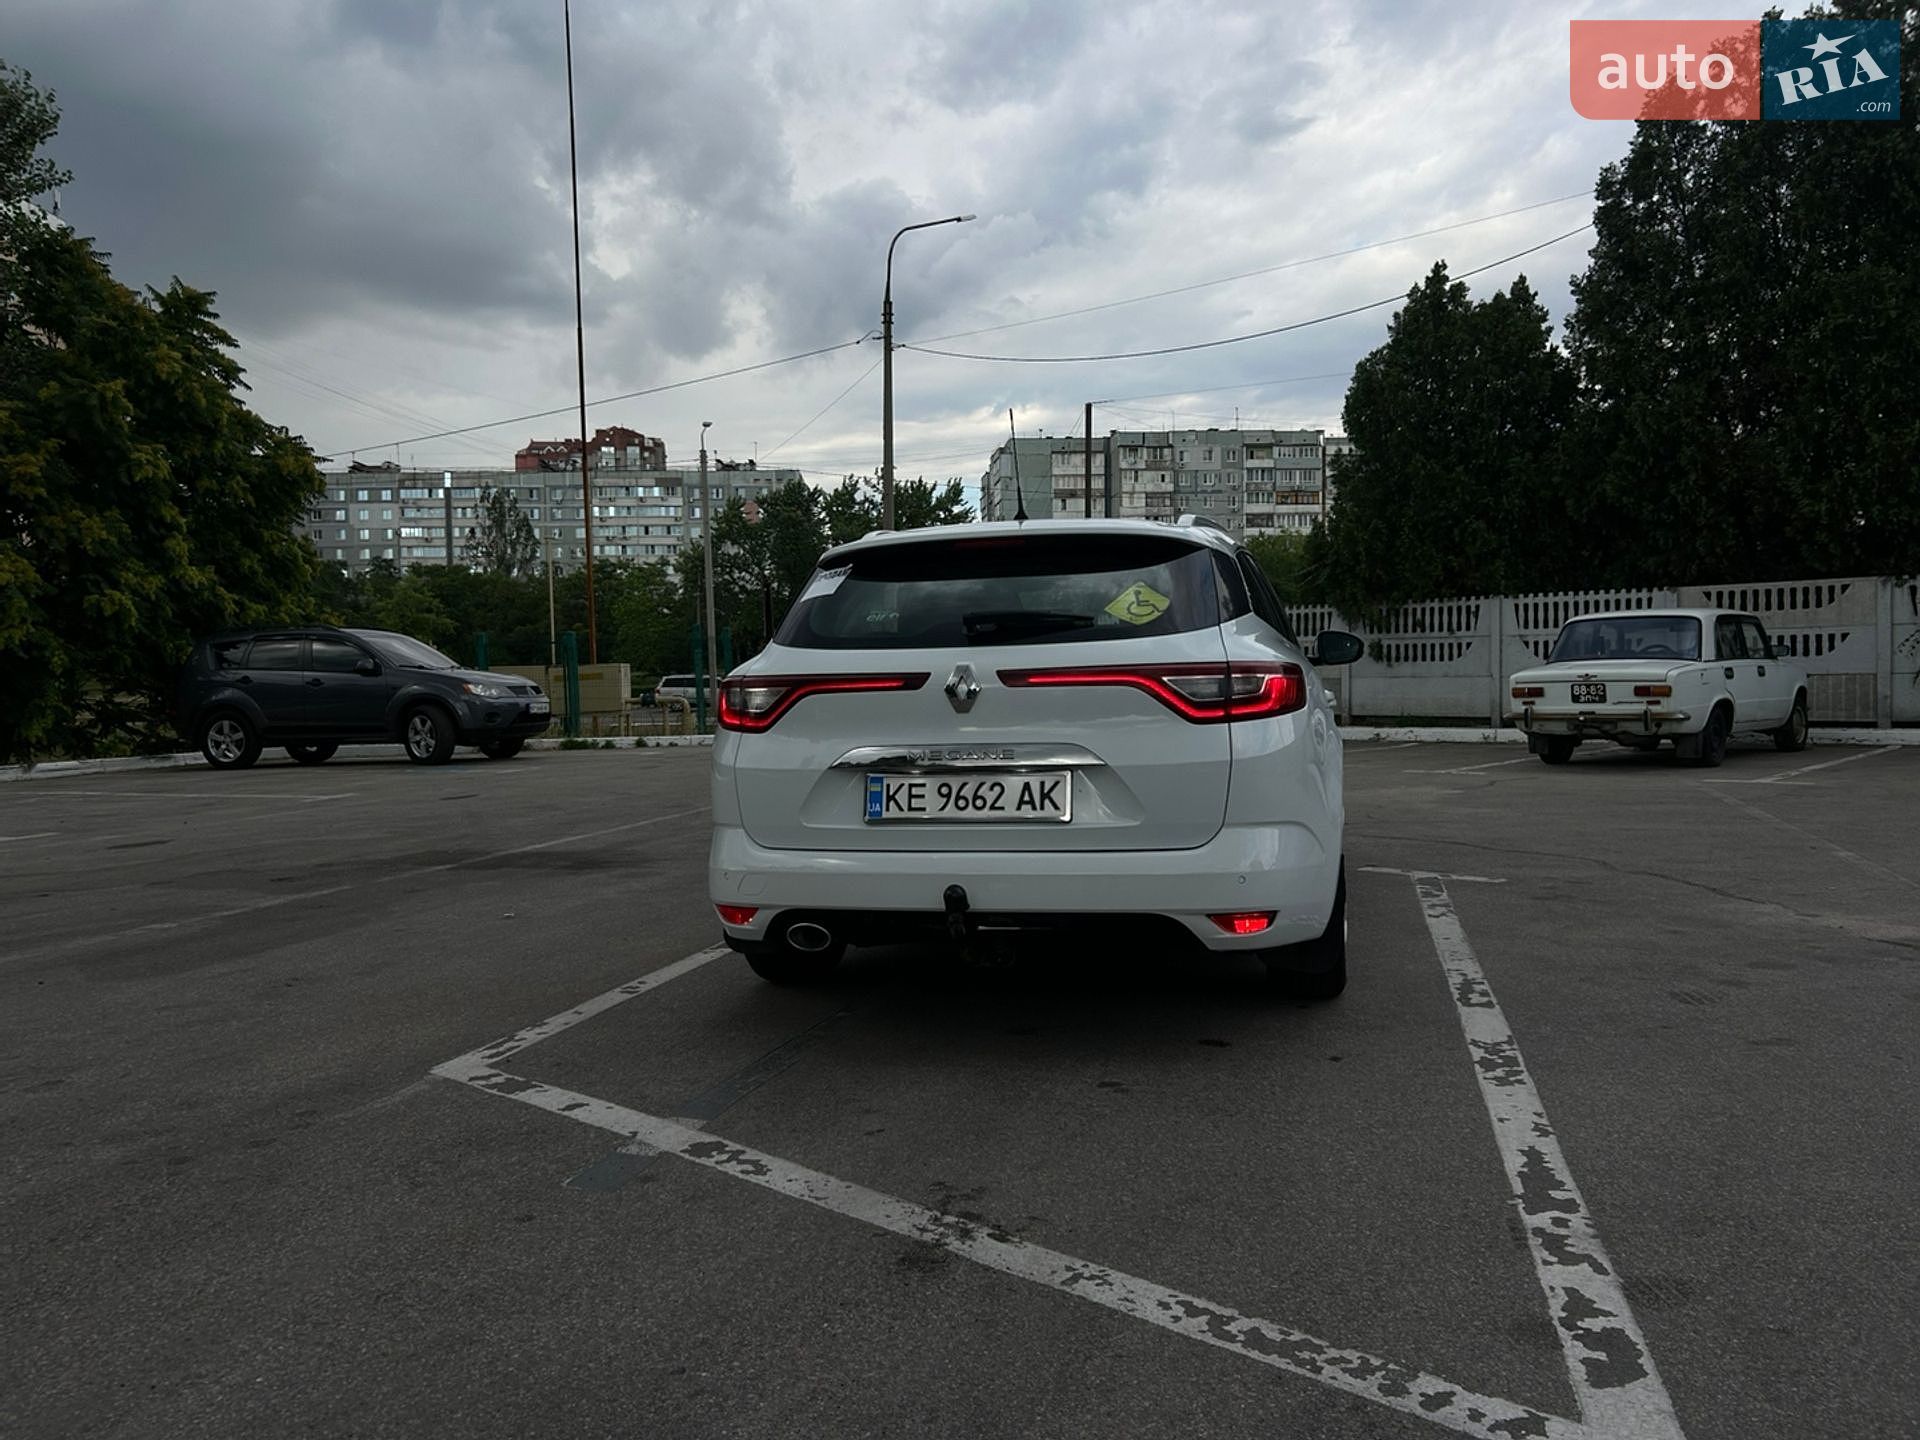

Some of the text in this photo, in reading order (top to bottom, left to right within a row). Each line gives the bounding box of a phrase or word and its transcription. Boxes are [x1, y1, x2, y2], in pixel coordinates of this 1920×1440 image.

[906, 749, 1015, 761] MEGANE
[885, 780, 1061, 812] KE 9662 AK
[868, 803, 881, 812] UA
